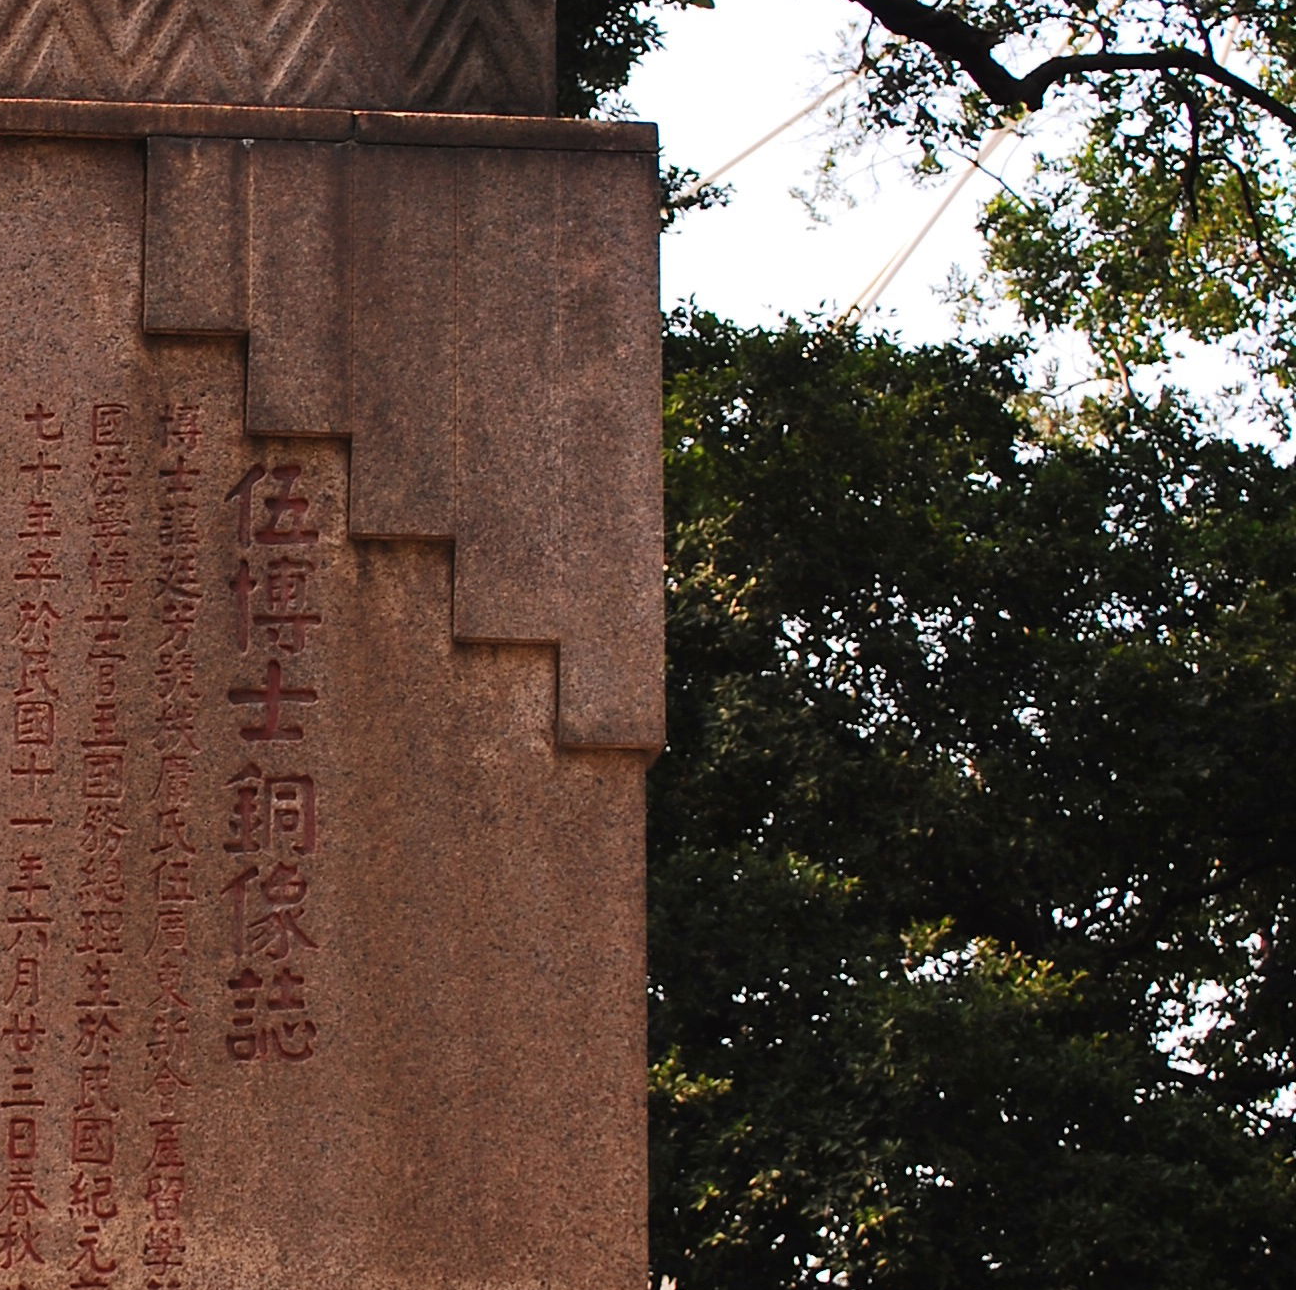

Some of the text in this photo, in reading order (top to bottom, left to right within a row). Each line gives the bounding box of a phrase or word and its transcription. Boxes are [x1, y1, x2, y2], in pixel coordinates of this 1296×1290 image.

[219, 462, 323, 1065] 伍博士銅像誌
